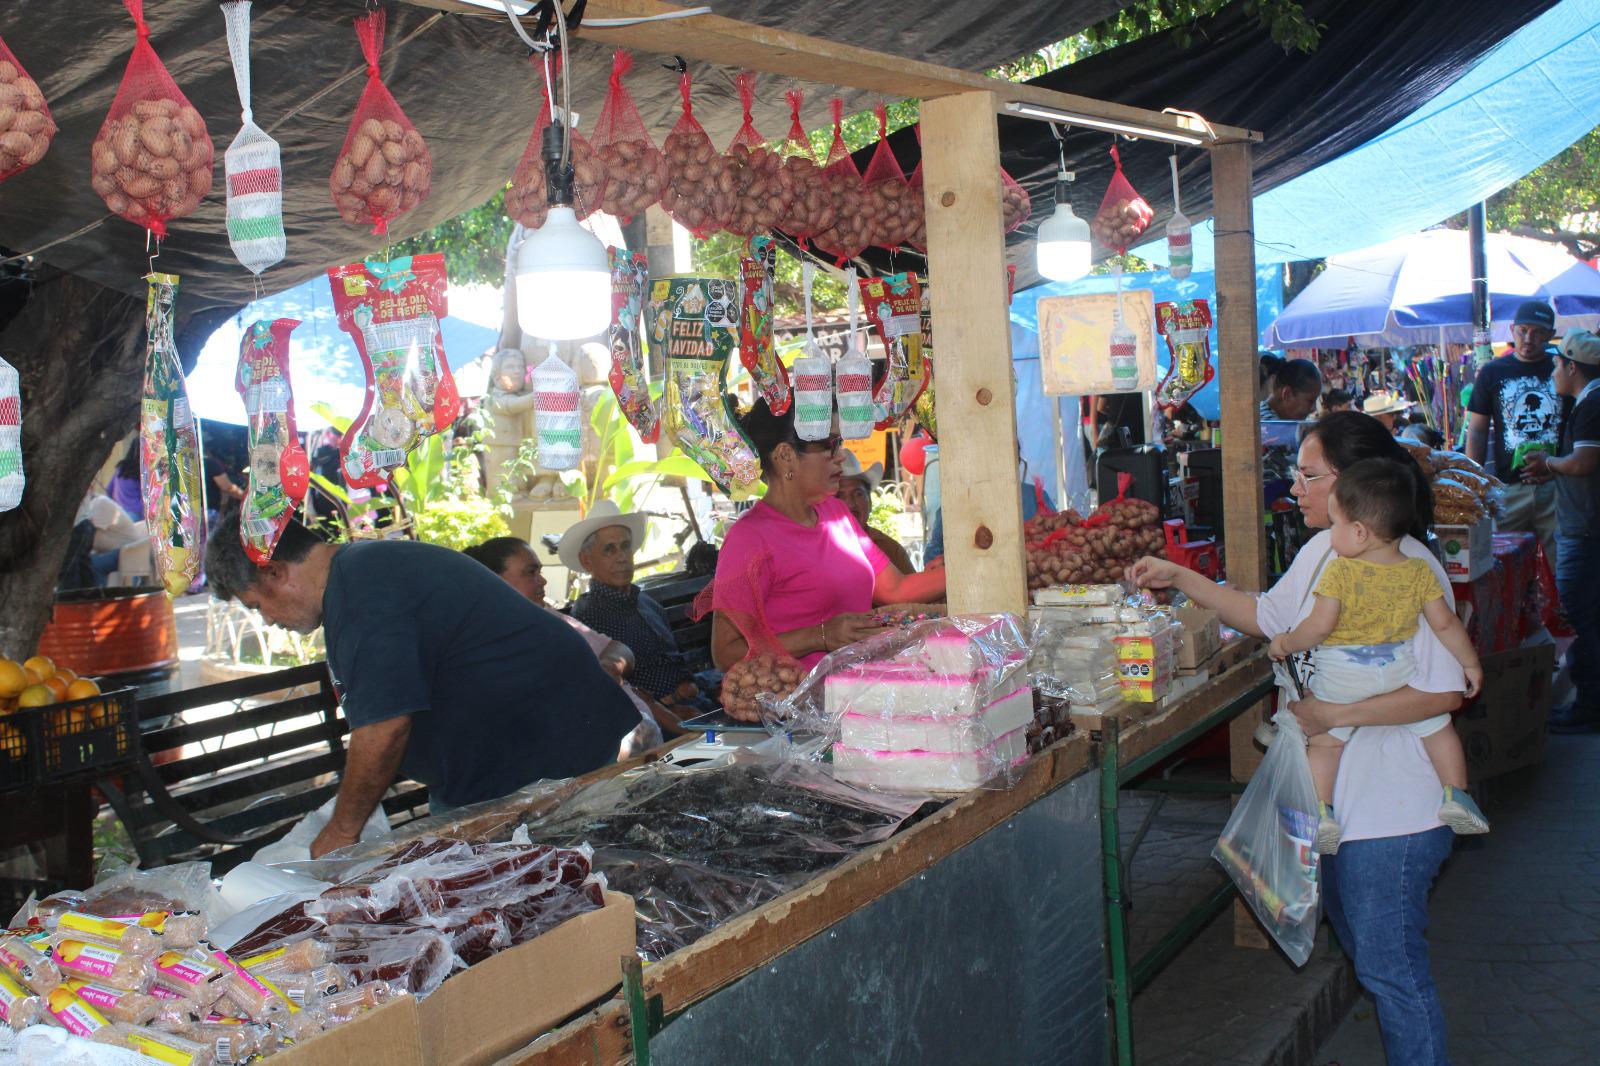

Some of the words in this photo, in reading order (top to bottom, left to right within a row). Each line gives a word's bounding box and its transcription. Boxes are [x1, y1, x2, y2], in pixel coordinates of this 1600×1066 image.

[380, 296, 407, 310] FELIZ
[410, 294, 426, 305] DIA
[381, 308, 393, 319] DE
[397, 304, 428, 317] REYES
[672, 321, 704, 337] FELIZ
